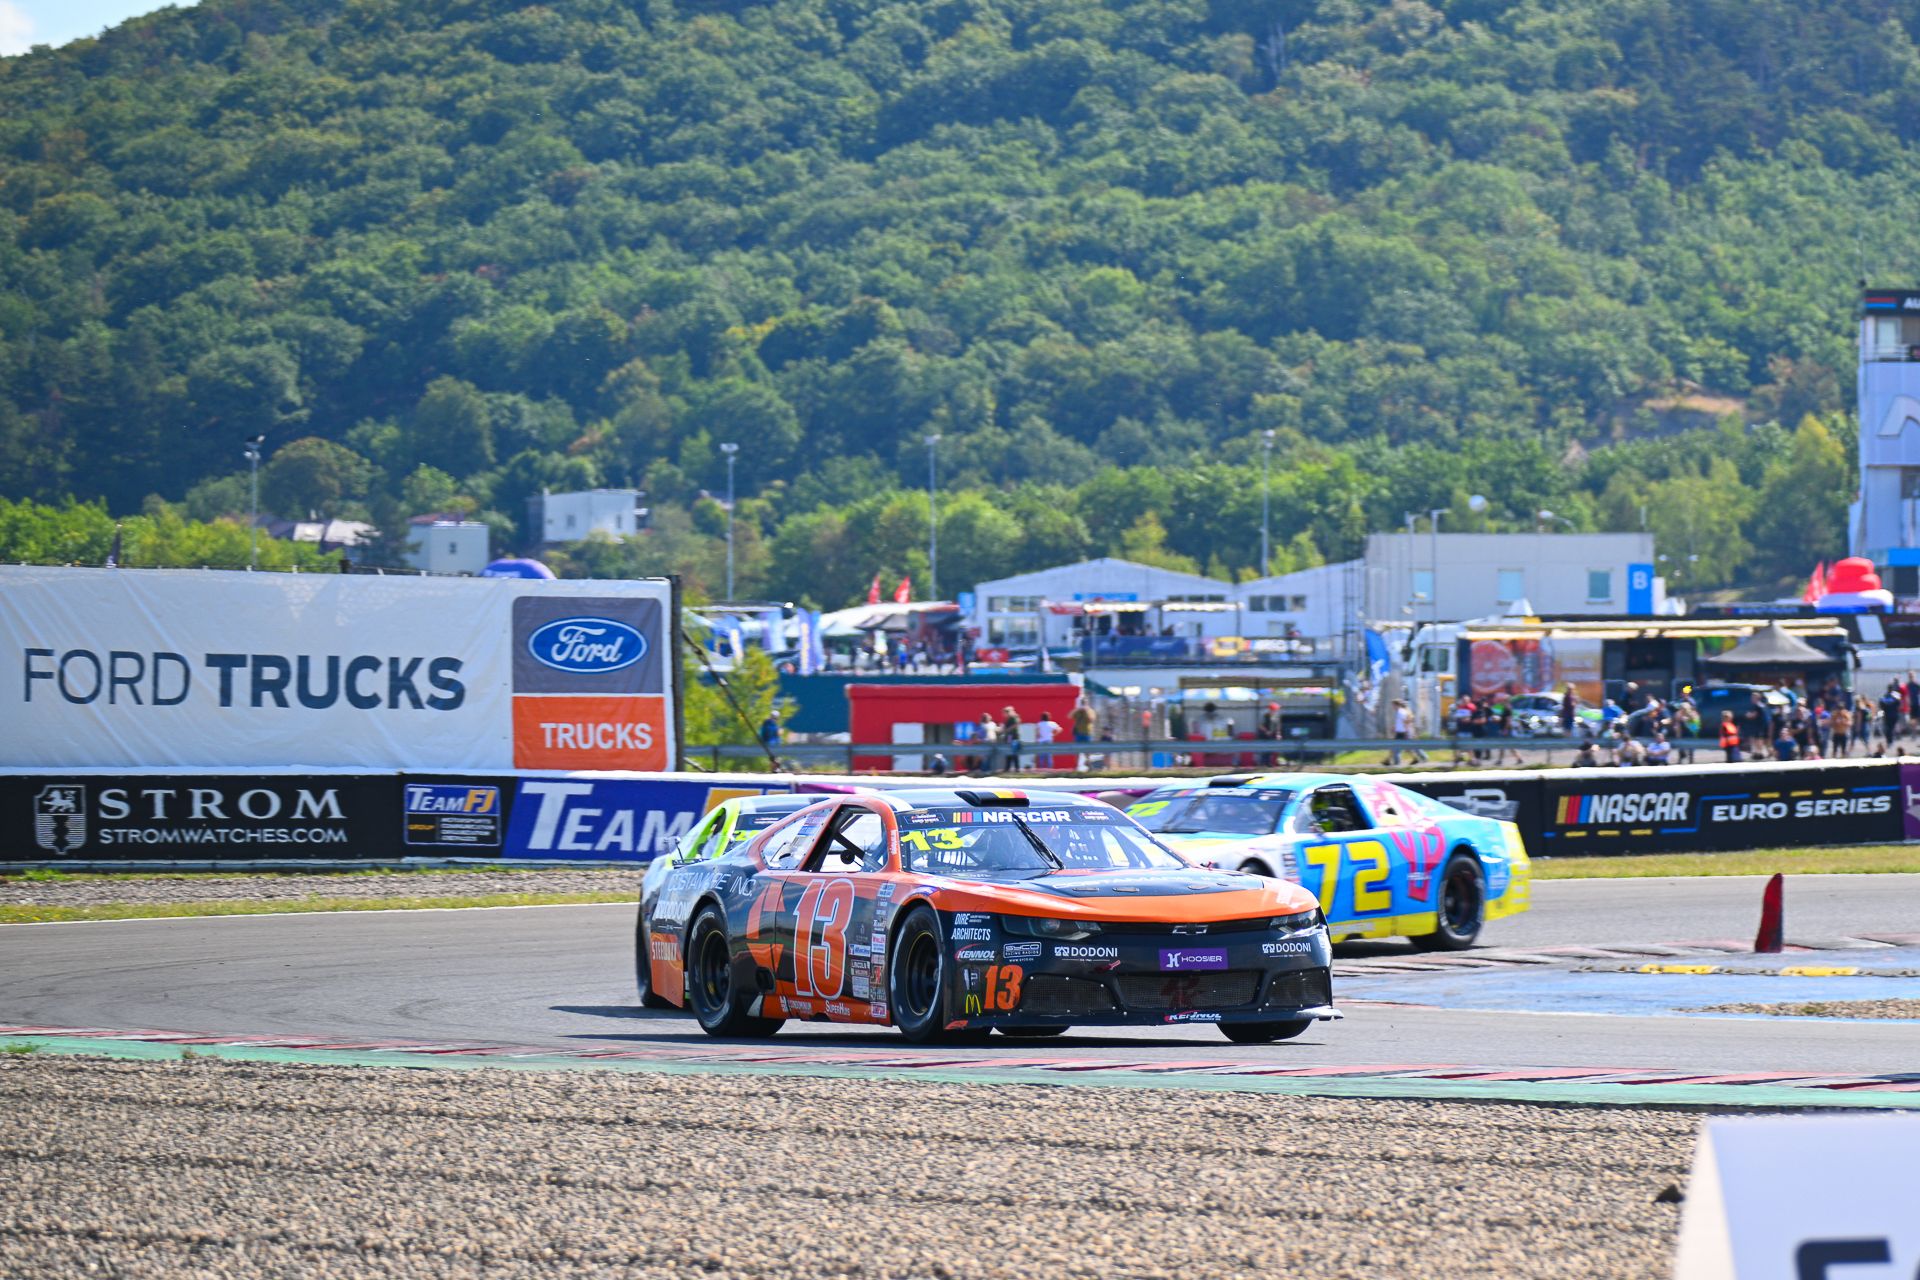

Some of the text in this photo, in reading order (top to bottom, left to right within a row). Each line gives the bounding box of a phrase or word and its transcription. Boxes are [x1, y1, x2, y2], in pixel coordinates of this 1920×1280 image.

[1633, 571, 1648, 590] B
[551, 624, 624, 664] Ford
[24, 647, 465, 711] FORD TRUCKS
[540, 722, 653, 750] TRUCKS
[99, 788, 348, 820] STROM
[1588, 792, 1690, 824] NASCAR
[1711, 803, 1788, 822] EURO
[1794, 795, 1892, 818] SERIES
[983, 811, 1072, 823] NASCAR
[99, 827, 348, 845] STROMWATCHES.COM
[901, 828, 964, 851] 13
[1304, 840, 1392, 917] 72
[792, 877, 856, 1001] 13
[950, 927, 991, 941] ARCHITECTS
[957, 950, 995, 959] KENNOL
[1071, 946, 1118, 958] DODONI
[1181, 955, 1223, 963] HOOSIER
[1275, 942, 1312, 954] DODONI
[984, 964, 1024, 1010] 13
